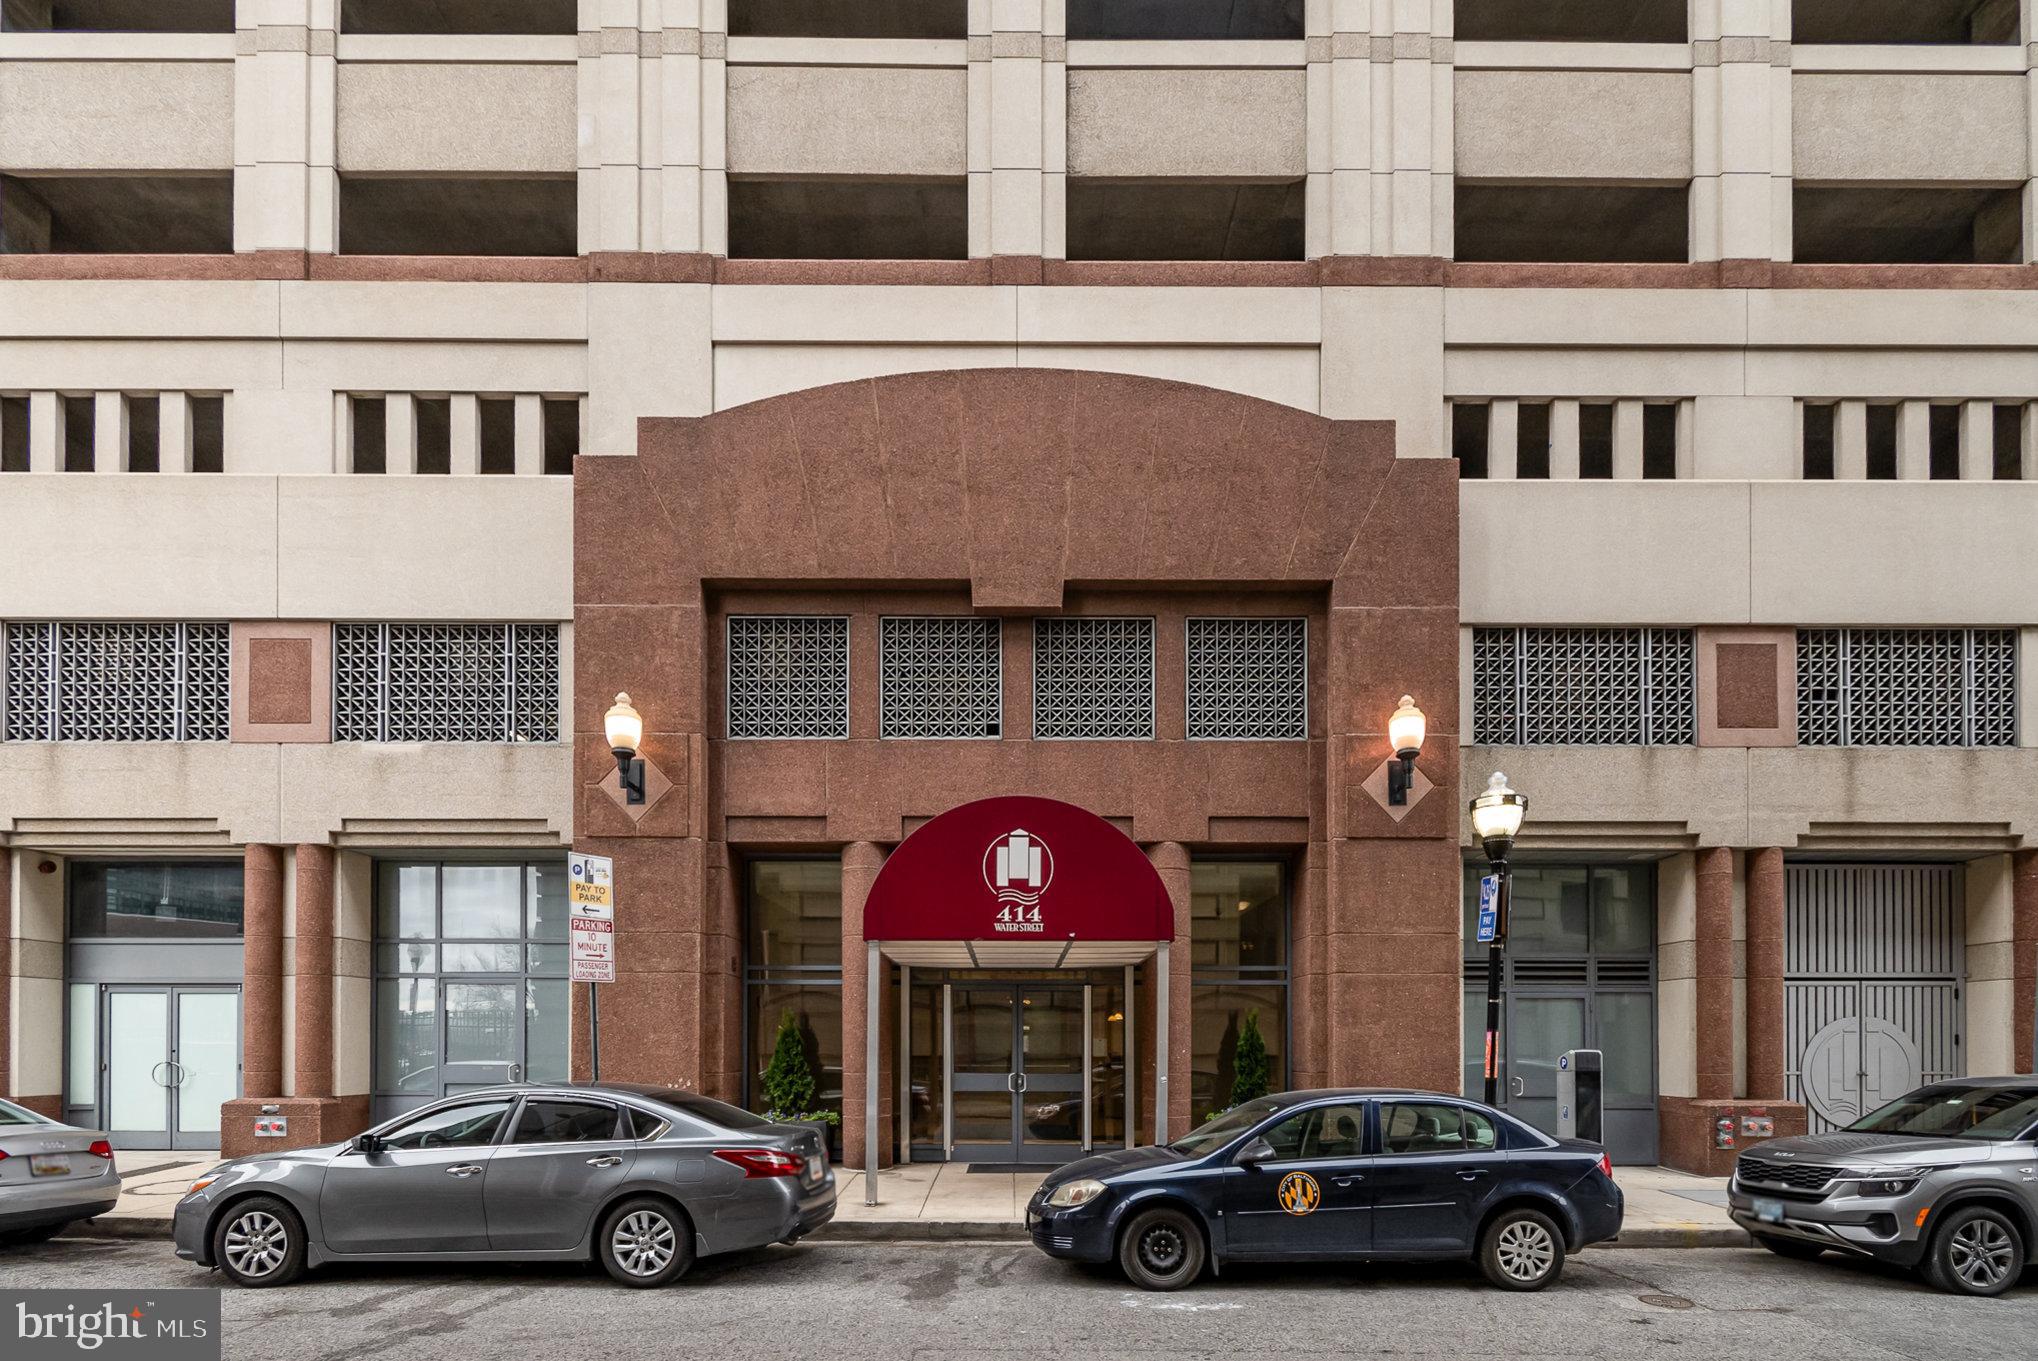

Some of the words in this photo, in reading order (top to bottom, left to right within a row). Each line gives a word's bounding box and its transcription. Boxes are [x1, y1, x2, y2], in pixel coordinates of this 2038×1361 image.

[576, 883, 591, 893] PAY
[594, 886, 606, 895] TO
[578, 892, 602, 903] PARK
[996, 904, 1042, 922] 414
[1483, 915, 1492, 925] PAY
[573, 919, 611, 932] PARKING
[994, 922, 1019, 932] WATER
[1019, 922, 1044, 932] STREET
[1480, 926, 1492, 936] HERE
[587, 932, 596, 942] 10
[577, 942, 608, 953] MINUTE
[577, 961, 608, 970] PASSENGER
[575, 970, 597, 979] LOADING
[598, 970, 610, 979] ZONE
